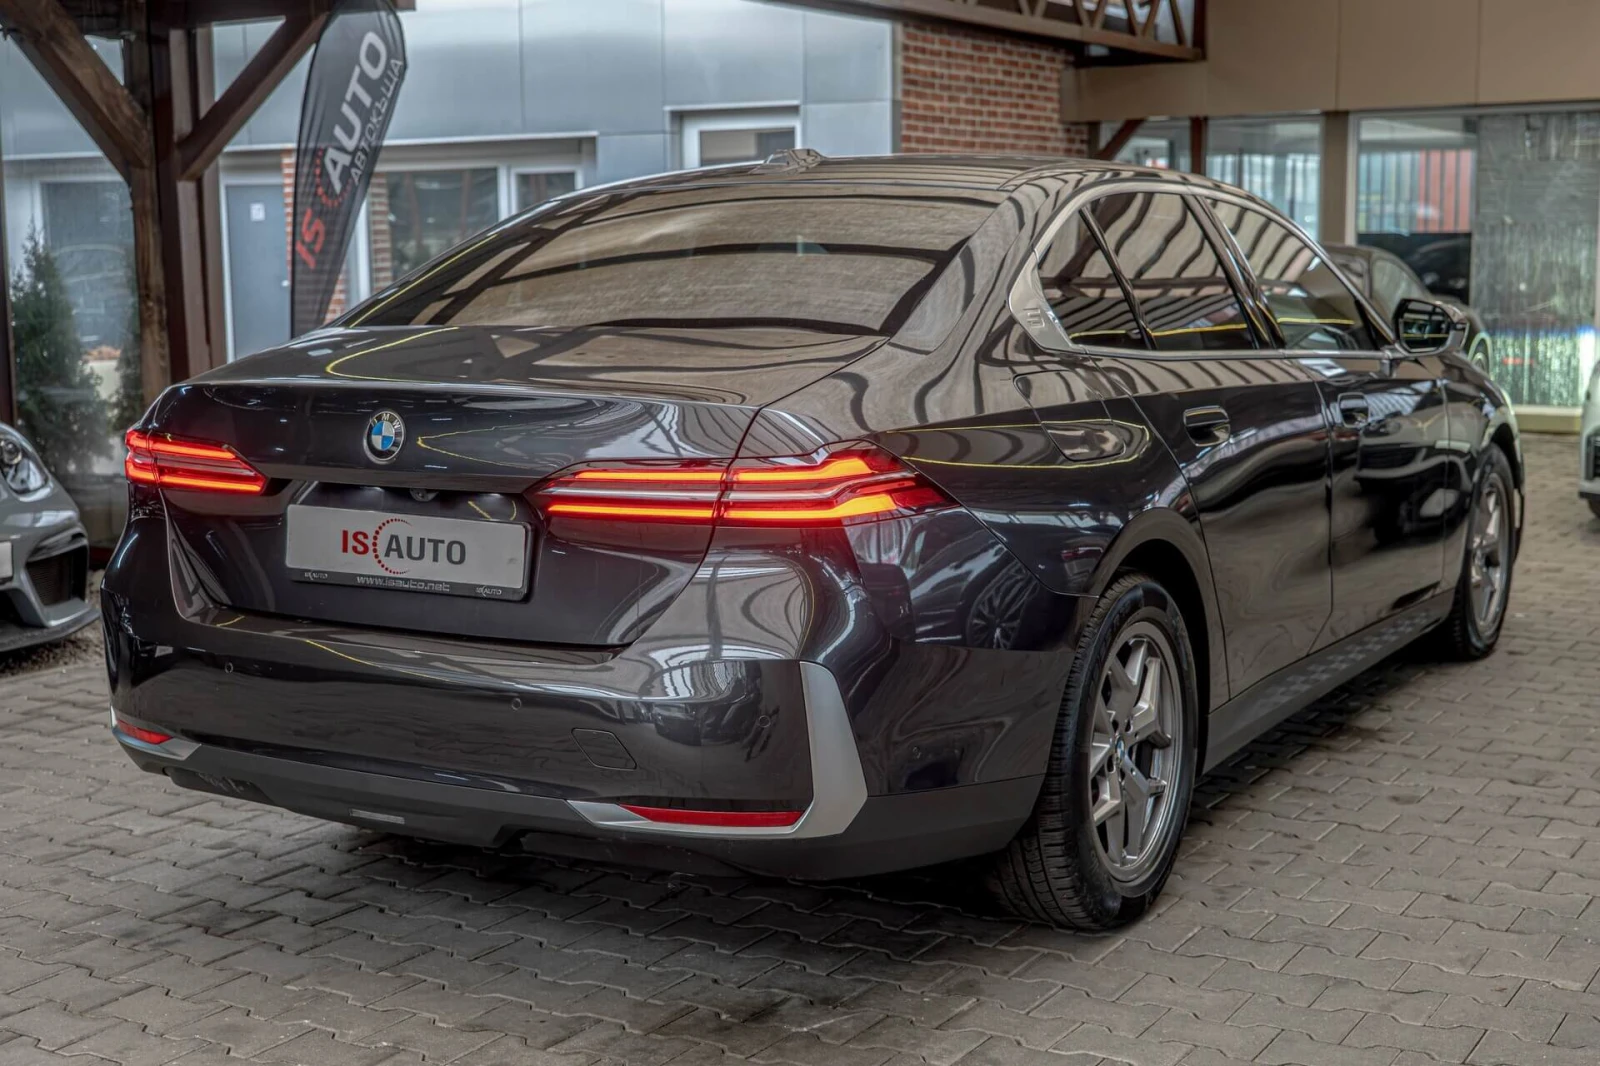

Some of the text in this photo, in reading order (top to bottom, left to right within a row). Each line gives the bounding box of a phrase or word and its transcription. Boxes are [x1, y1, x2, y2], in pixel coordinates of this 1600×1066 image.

[295, 31, 387, 269] IS AUTO
[350, 58, 404, 187] АВТОКЪЩА
[341, 529, 466, 565] IS AUTO
[356, 575, 451, 592] www.isauto.net
